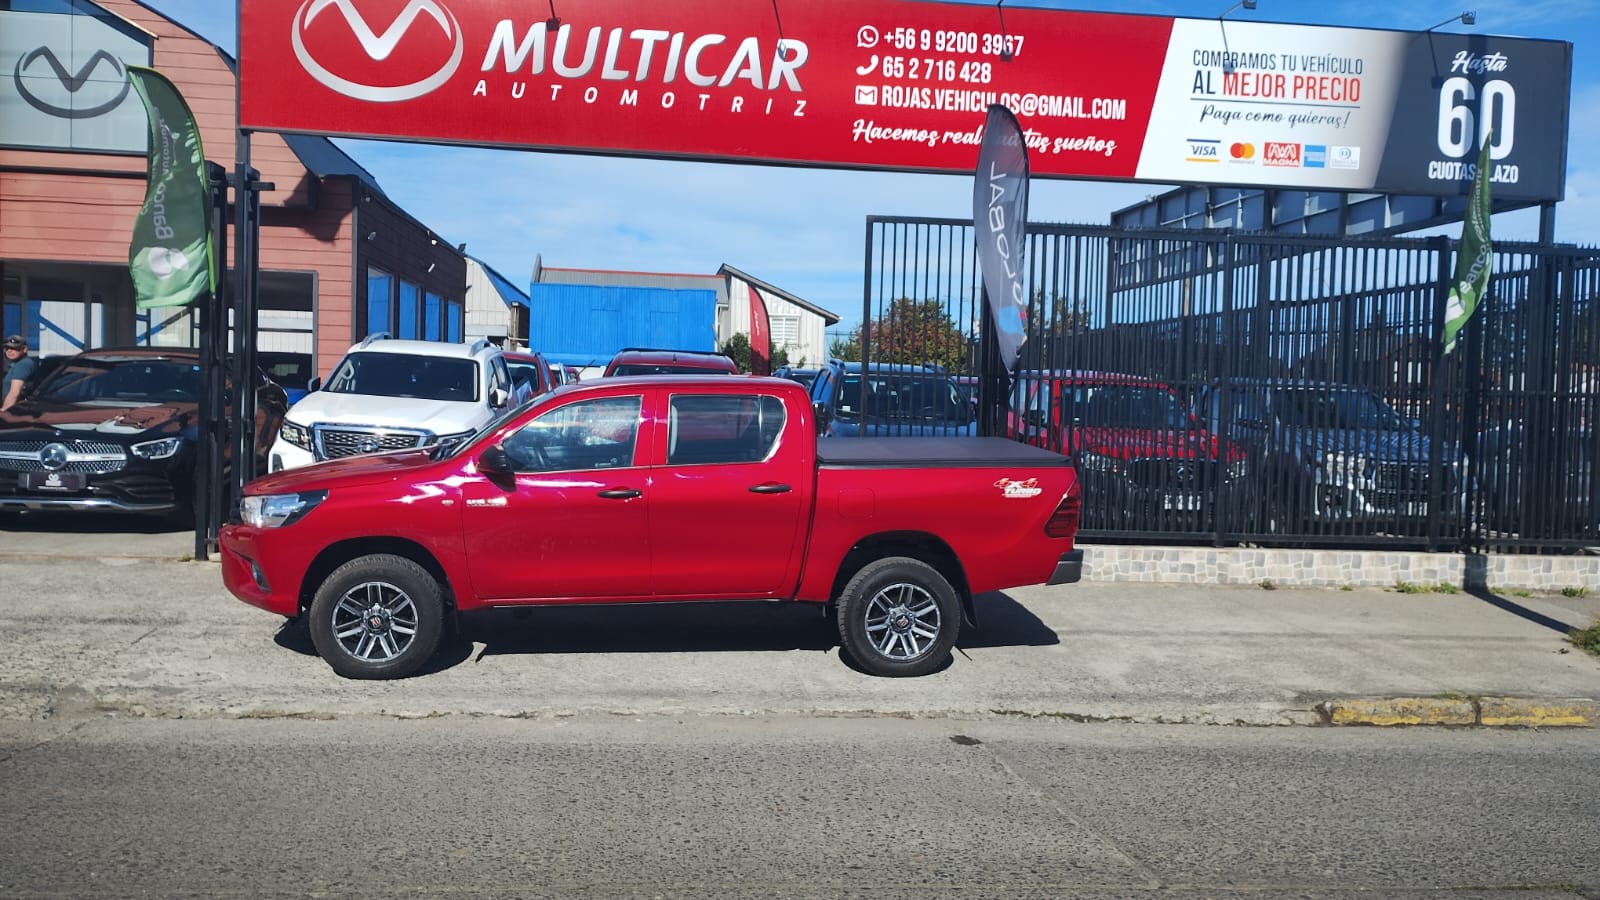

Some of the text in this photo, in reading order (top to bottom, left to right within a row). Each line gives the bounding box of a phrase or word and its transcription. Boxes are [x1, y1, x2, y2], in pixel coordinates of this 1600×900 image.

[481, 19, 809, 92] MULTICAR
[884, 28, 1025, 57] +56 9 9200 3967
[883, 56, 992, 84] 65 2 716 428
[1193, 50, 1363, 75] COMPRAMOS TU VEHÍCULO
[1451, 50, 1508, 74] Hasta
[473, 79, 808, 117] AUTOMOTRIZ
[1192, 70, 1361, 103] AL MEJOR PRECIO
[1199, 104, 1351, 129] Paga como quieras!
[1438, 77, 1515, 160] 60
[852, 119, 940, 147] Hacemos
[1022, 128, 1052, 154] tus
[1053, 134, 1118, 157] sueños
[1191, 145, 1217, 157] VISA
[1263, 157, 1300, 167] MAGNA
[1428, 161, 1476, 181] CUOTAS
